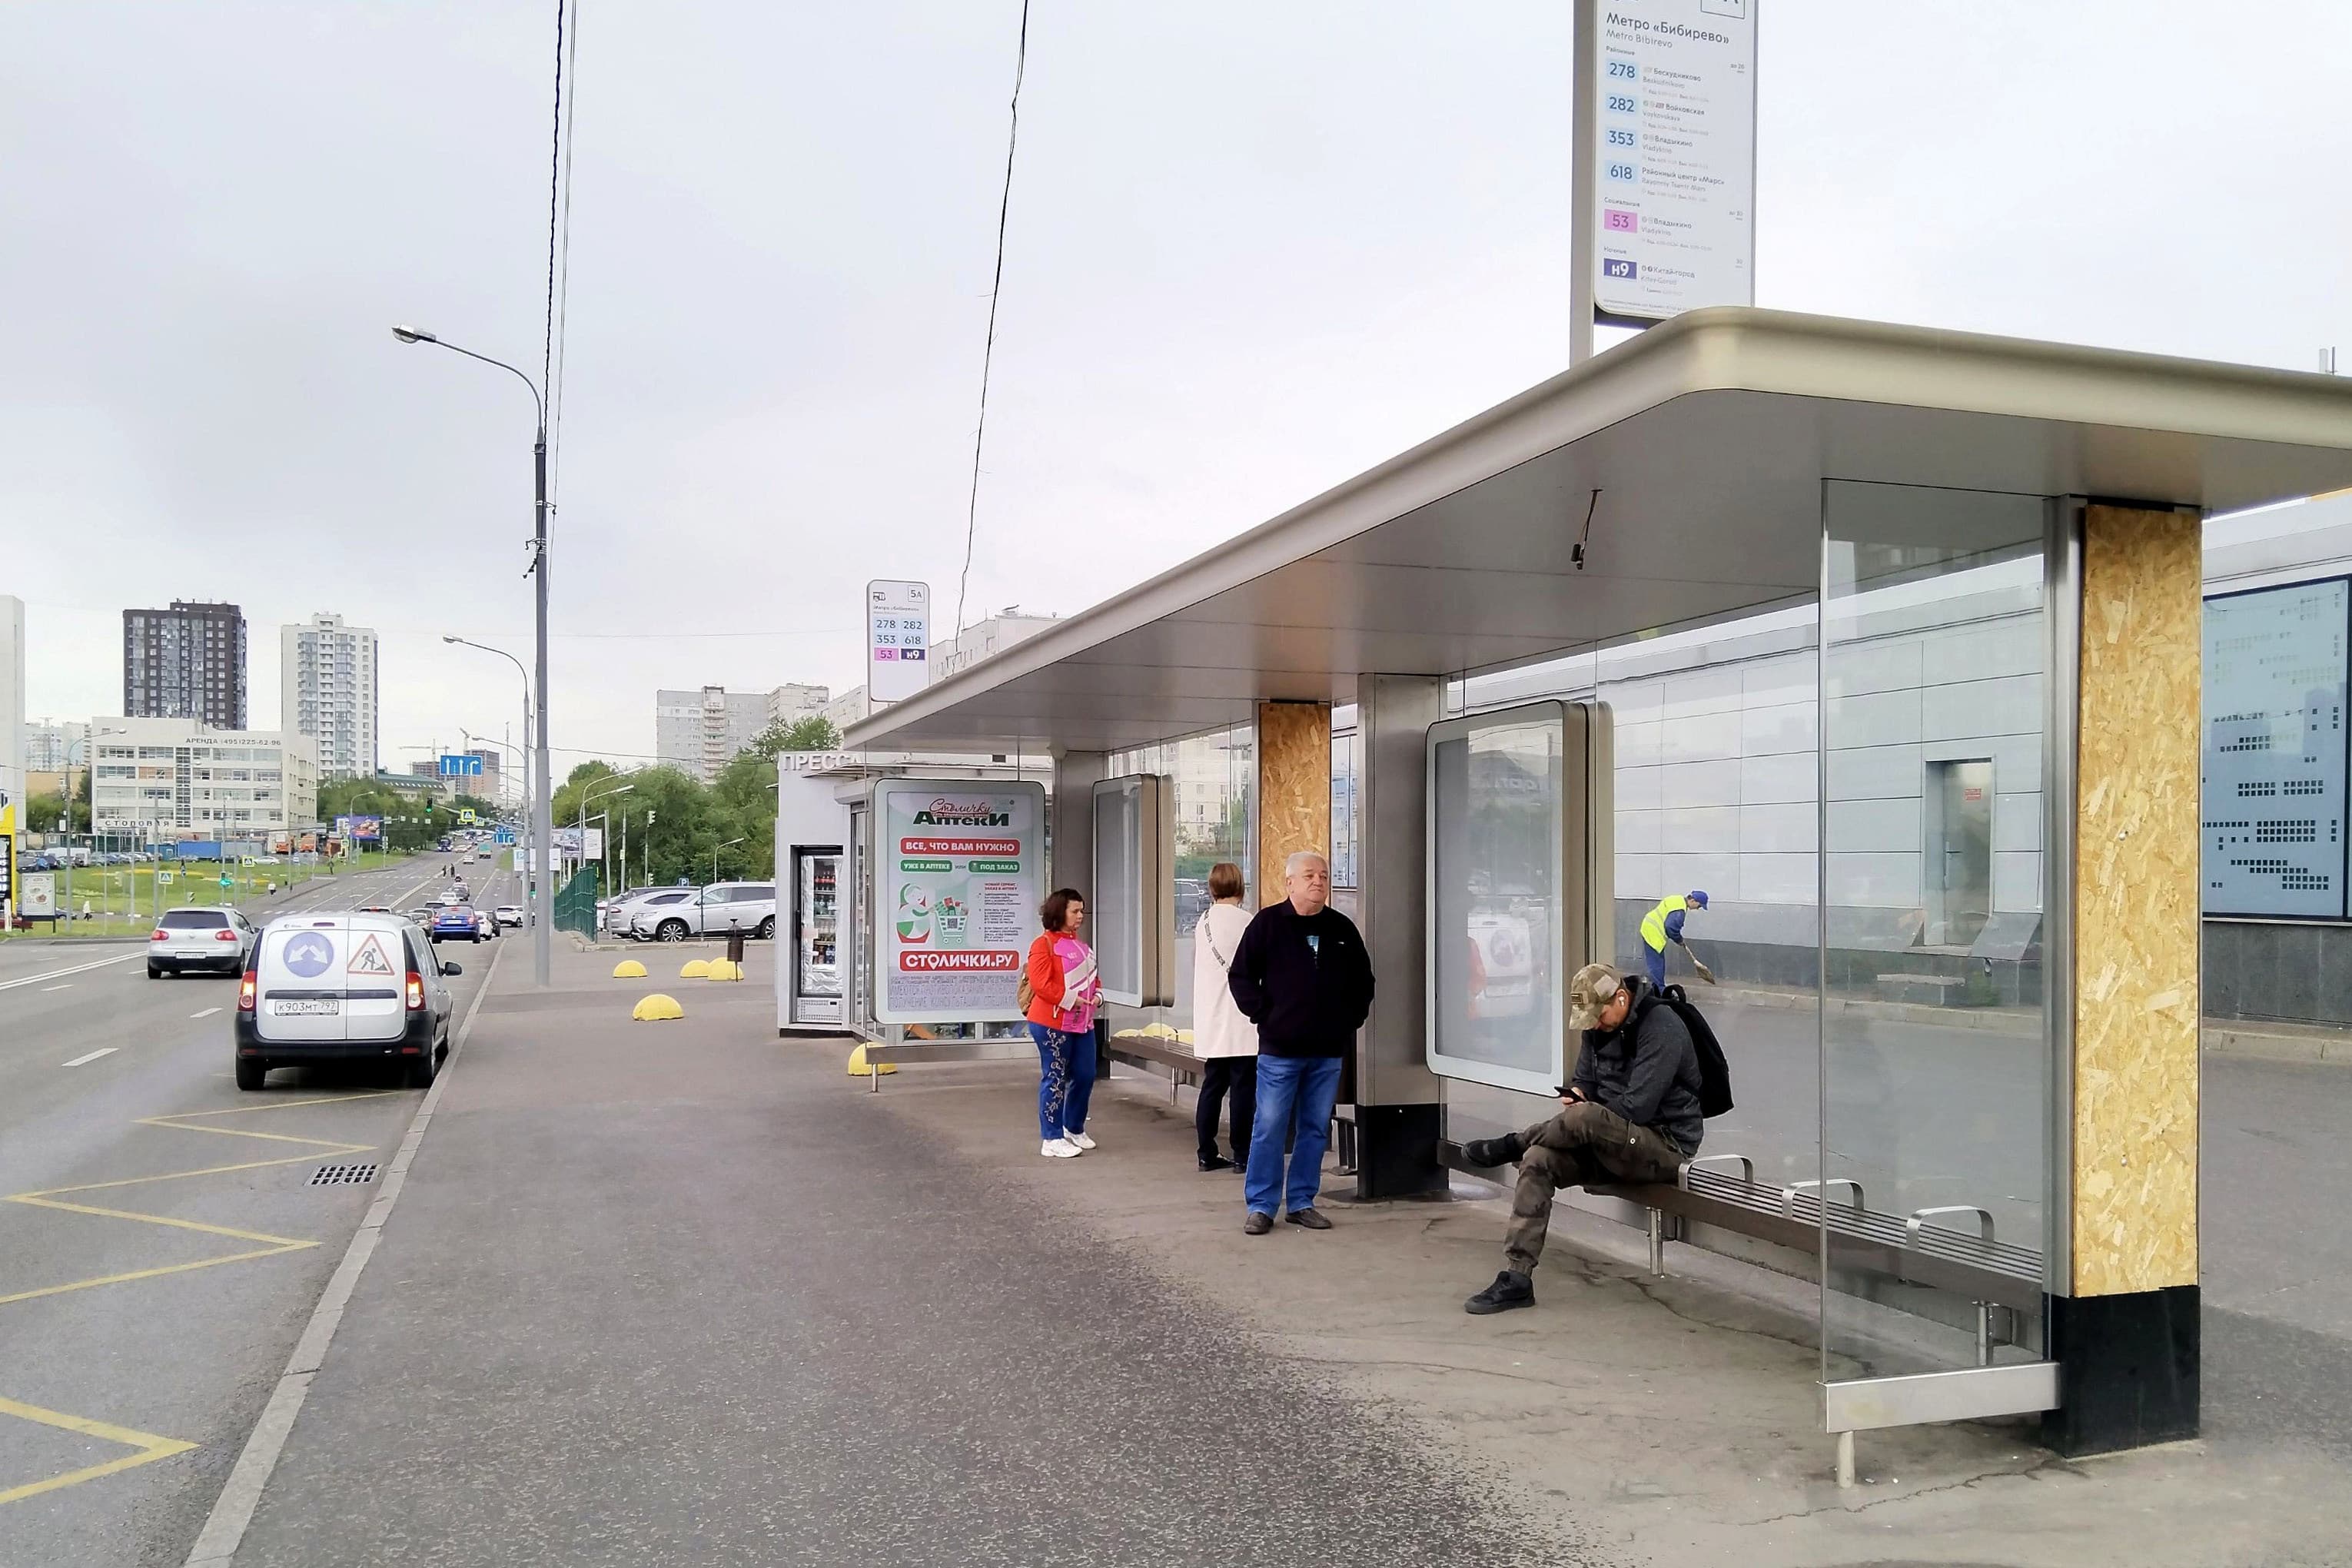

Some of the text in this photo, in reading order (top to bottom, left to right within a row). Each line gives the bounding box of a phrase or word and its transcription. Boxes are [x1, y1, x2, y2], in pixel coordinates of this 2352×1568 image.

[1606, 12, 1729, 45] Метро «Бибирево»
[1606, 28, 1633, 42] Metro
[1609, 62, 1636, 78] 278
[1609, 96, 1635, 112] 282
[1608, 130, 1634, 146] 353
[1610, 164, 1633, 180] 618
[1612, 214, 1629, 228] 53
[876, 620, 922, 630] 278 282
[876, 635, 922, 645] 353 618
[880, 650, 892, 659] 53
[905, 842, 1015, 852] ВСЕ, ЧТО ВАМ НУЖНО
[905, 953, 1014, 970] СТОЛИЧКИ.РУ
